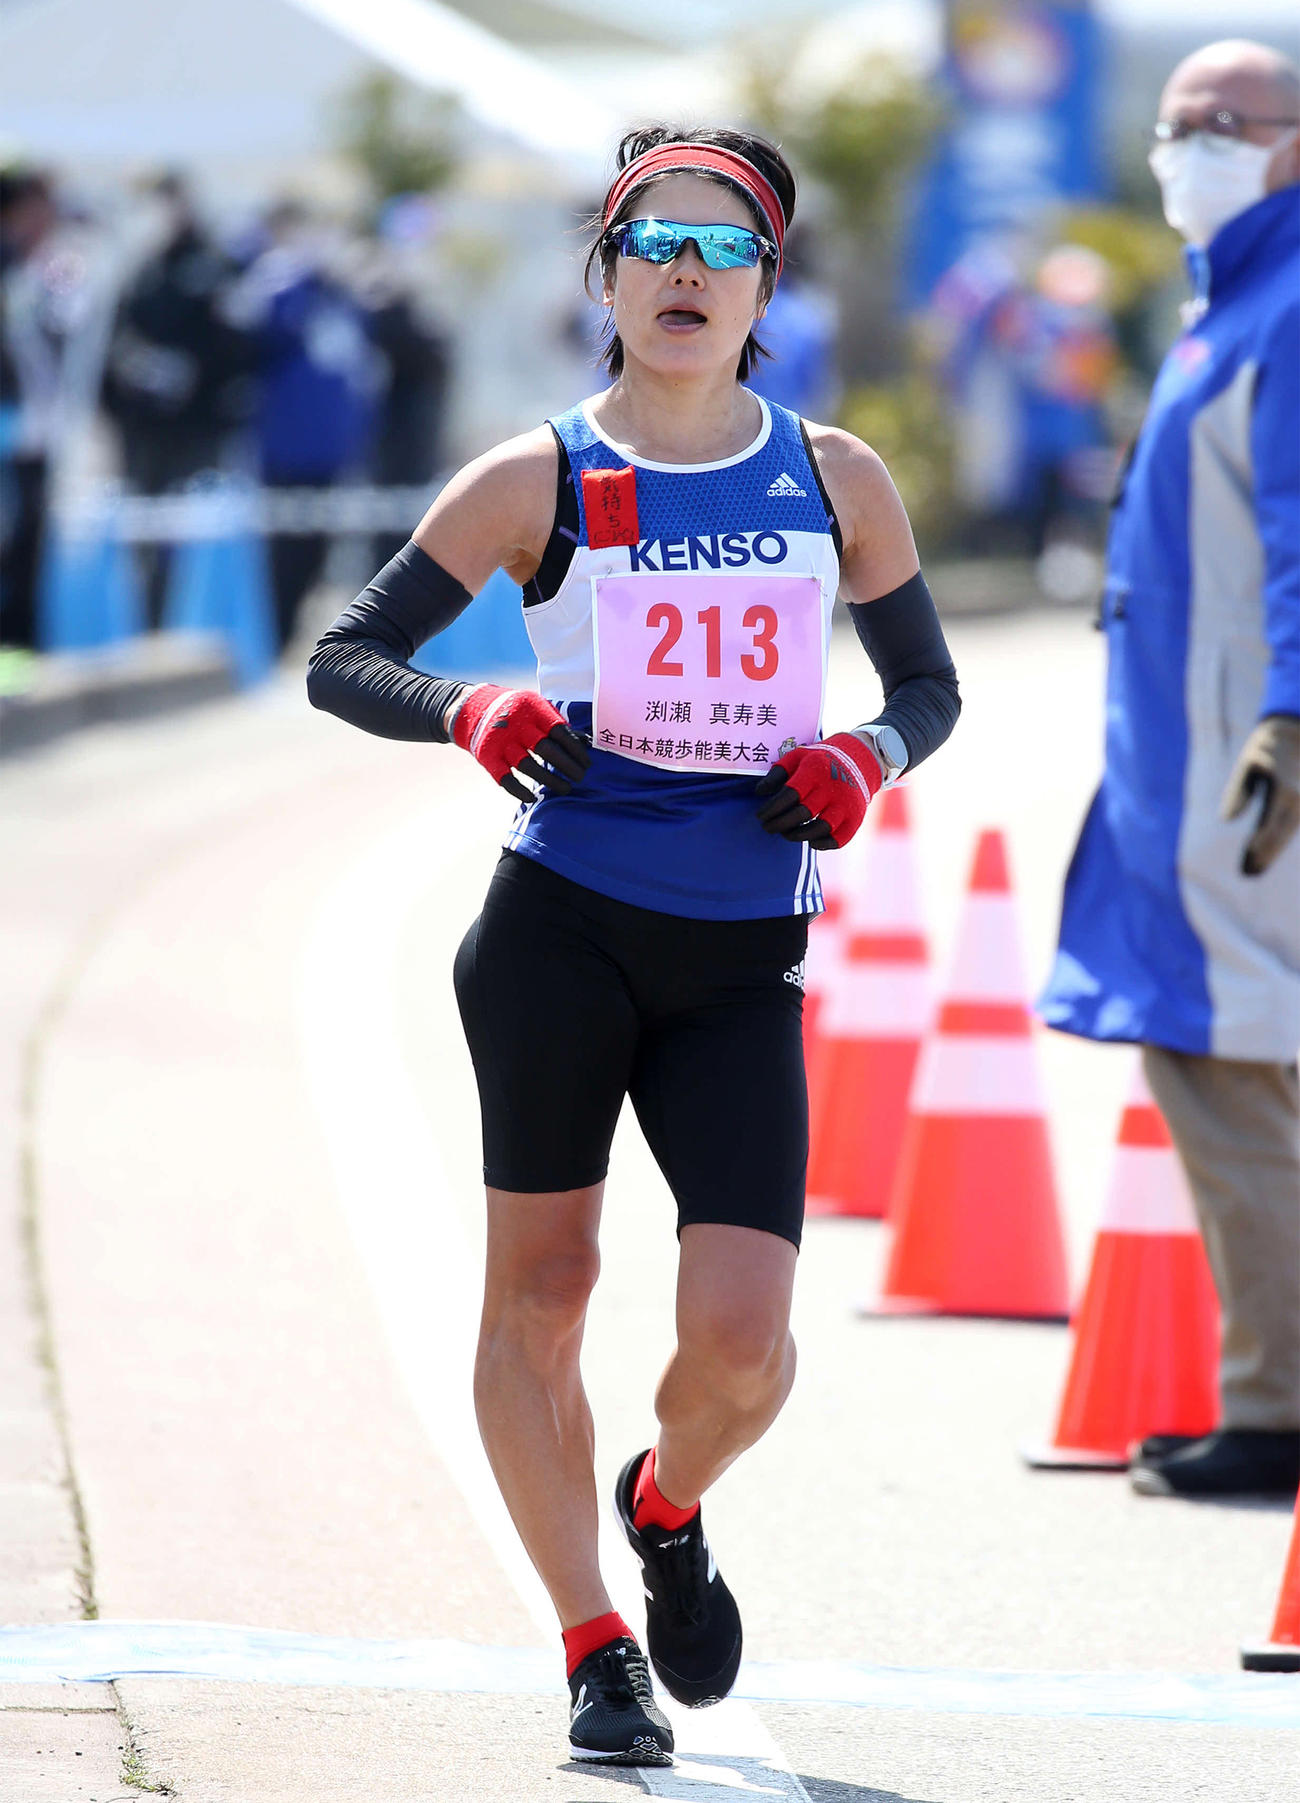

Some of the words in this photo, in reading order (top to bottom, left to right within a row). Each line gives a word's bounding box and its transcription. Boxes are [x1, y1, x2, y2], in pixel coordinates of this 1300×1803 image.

[766, 487, 808, 498] adidas
[629, 531, 788, 572] KENSO
[646, 602, 779, 681] 213
[645, 700, 692, 723] 渕瀬
[709, 702, 777, 726] 真寿美
[599, 728, 770, 763] 全日本競歩能美大会
